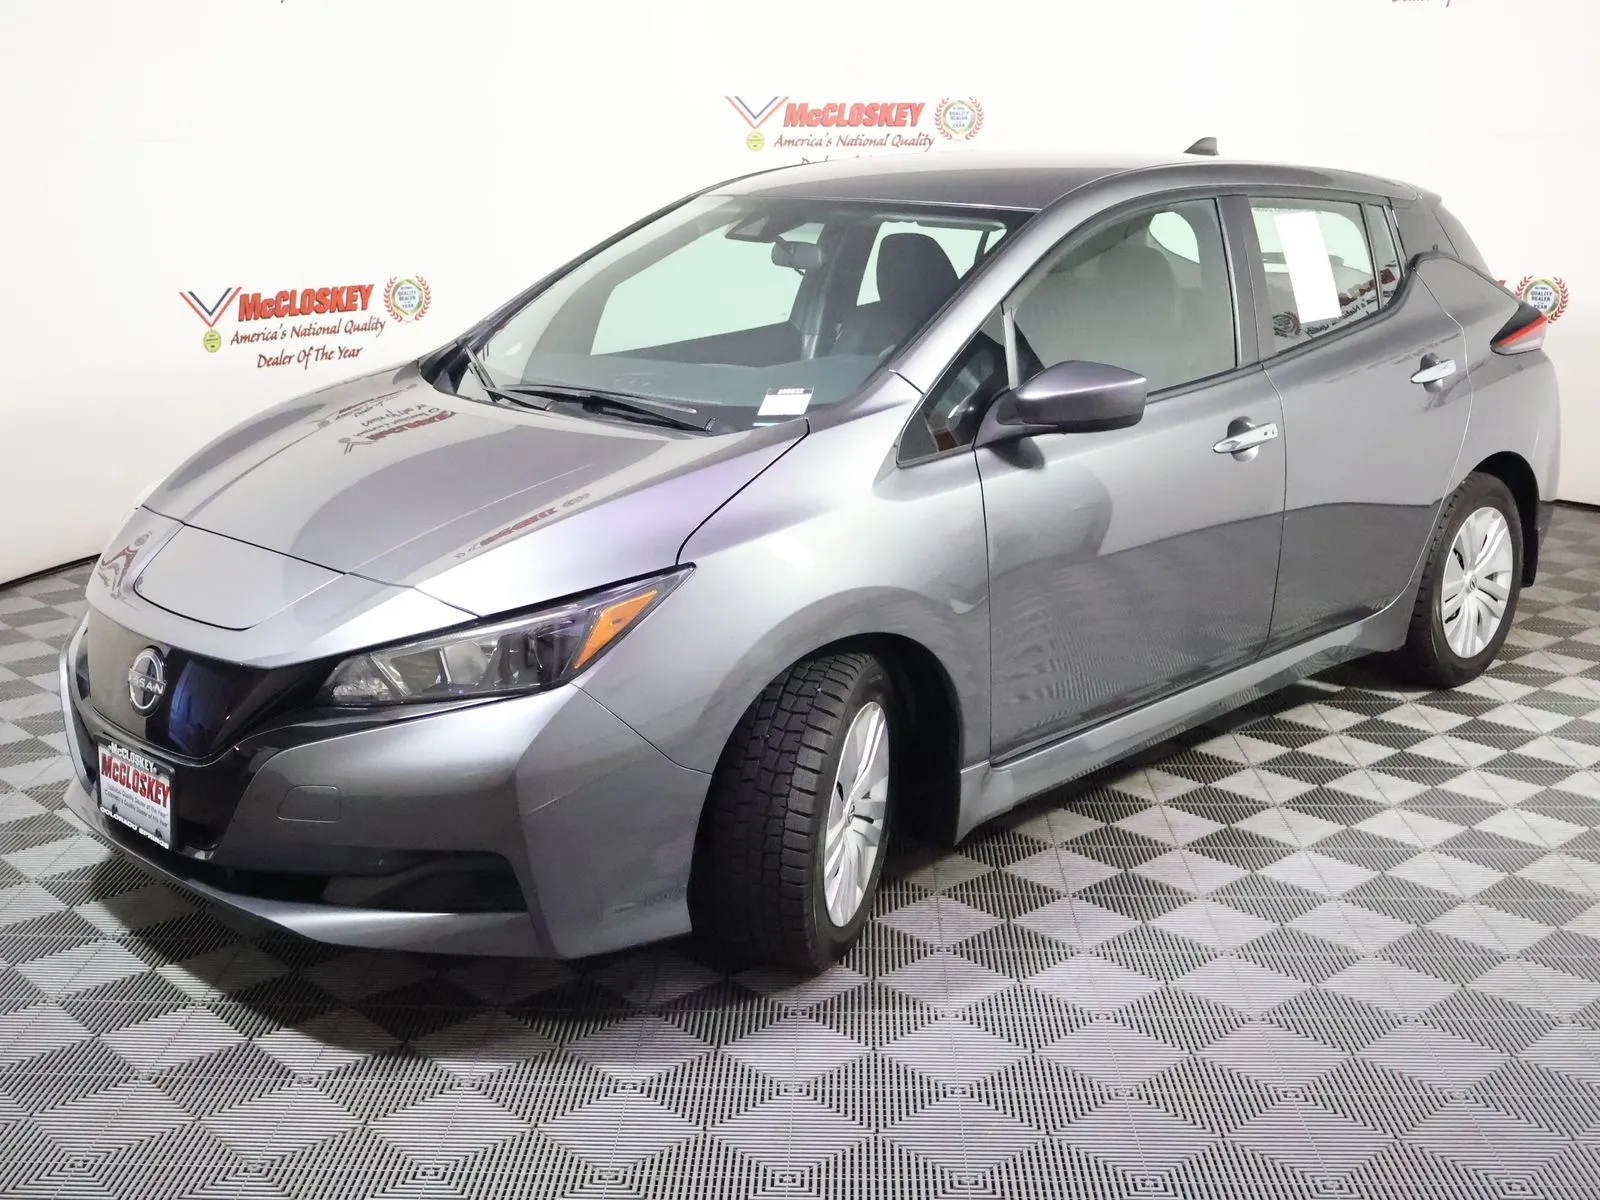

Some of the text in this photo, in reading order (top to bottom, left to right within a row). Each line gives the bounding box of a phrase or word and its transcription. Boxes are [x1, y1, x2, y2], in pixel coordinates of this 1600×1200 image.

[783, 102, 926, 128] McCLOSKEY
[773, 131, 833, 148] America's
[836, 132, 891, 148] National
[892, 132, 936, 152] Quality
[238, 284, 375, 322] McCLOSKEY
[230, 323, 287, 346] America's
[290, 318, 342, 339] National
[344, 315, 387, 338] Quality
[257, 344, 363, 371] Dealer Of The Year
[130, 669, 164, 695] SSAN
[101, 752, 171, 808] McCLOSKEY
